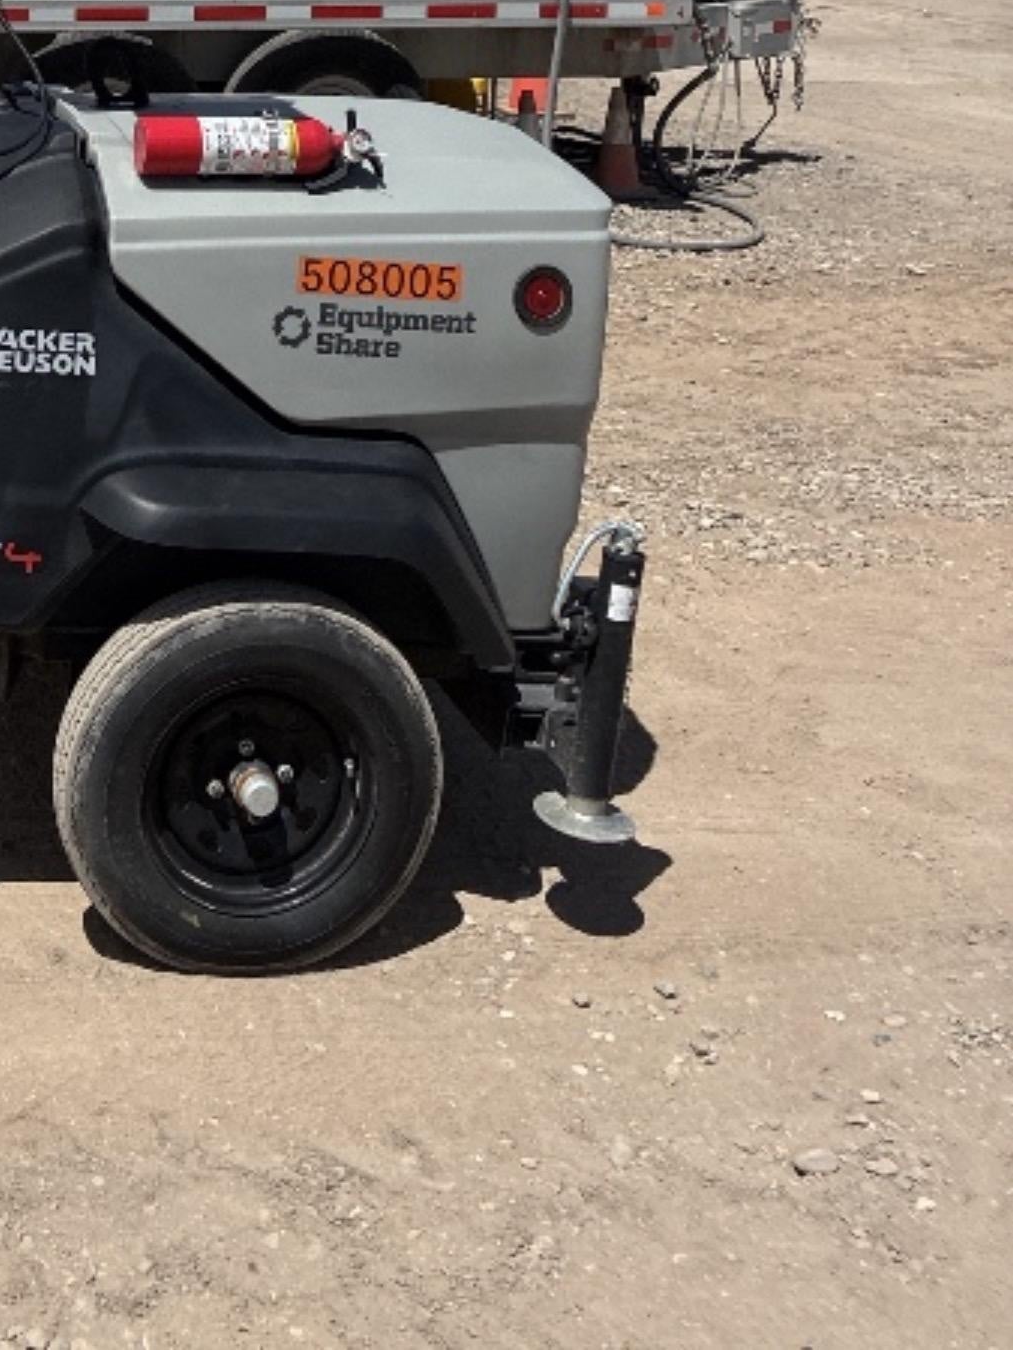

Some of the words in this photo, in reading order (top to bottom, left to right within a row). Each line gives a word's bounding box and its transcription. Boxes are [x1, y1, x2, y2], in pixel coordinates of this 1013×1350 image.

[301, 258, 457, 300] 508005
[317, 303, 477, 335] Equipment
[315, 332, 403, 358] Share
